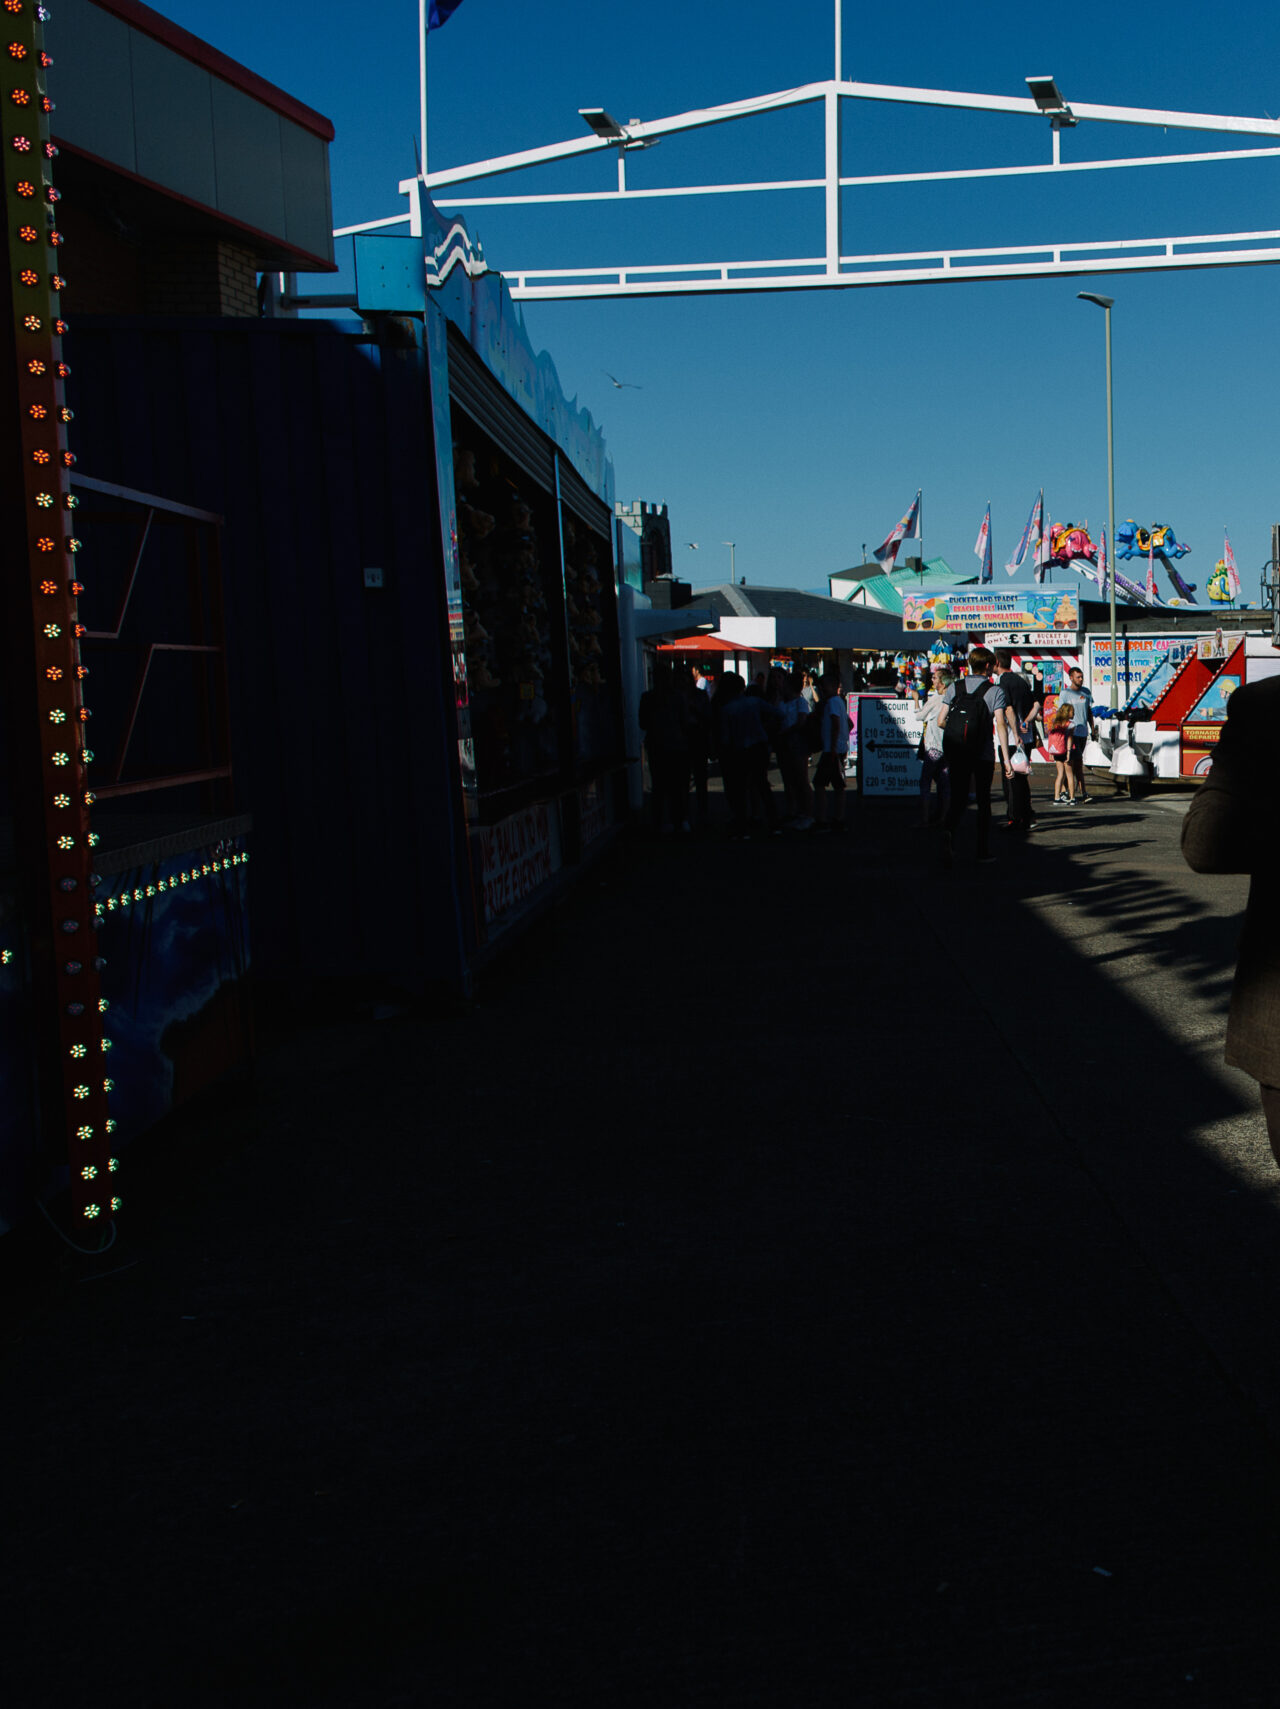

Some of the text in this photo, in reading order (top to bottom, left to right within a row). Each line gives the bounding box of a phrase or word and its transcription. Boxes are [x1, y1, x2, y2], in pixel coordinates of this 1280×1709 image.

[949, 596, 978, 604] BUCKETS
[976, 604, 995, 612] BALLS
[984, 612, 1024, 620] SUNGLASSES
[988, 621, 1023, 629] NOVELTIES
[1008, 633, 1032, 645] £1
[876, 700, 909, 711] Discount
[880, 714, 906, 724] Tokens
[865, 728, 878, 738] £10
[886, 728, 895, 738] 25
[877, 749, 910, 759] Discount
[881, 762, 907, 772] Tokens
